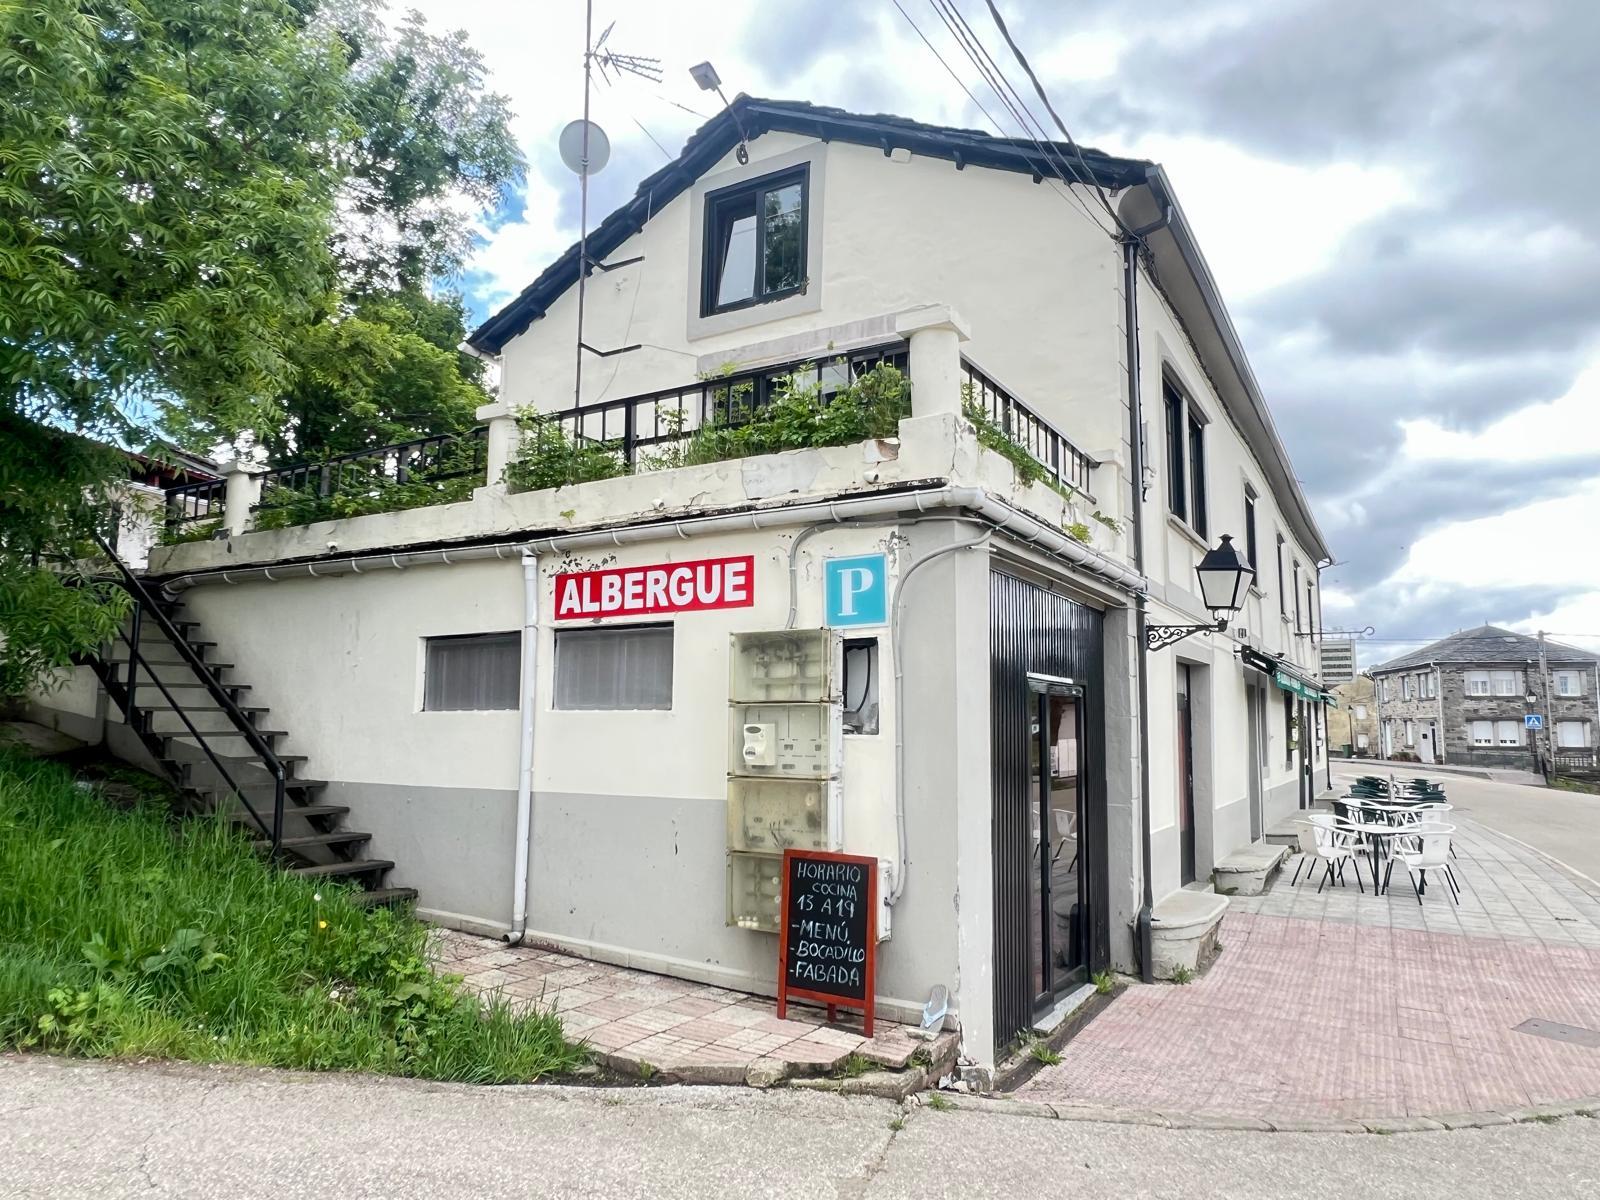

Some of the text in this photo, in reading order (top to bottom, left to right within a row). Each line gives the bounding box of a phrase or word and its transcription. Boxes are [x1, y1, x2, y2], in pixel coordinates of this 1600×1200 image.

[559, 561, 747, 615] ALBERGUE
[836, 567, 874, 617] P
[797, 862, 861, 882] HORARIO
[812, 882, 857, 902] COCINA
[796, 894, 814, 911] 13
